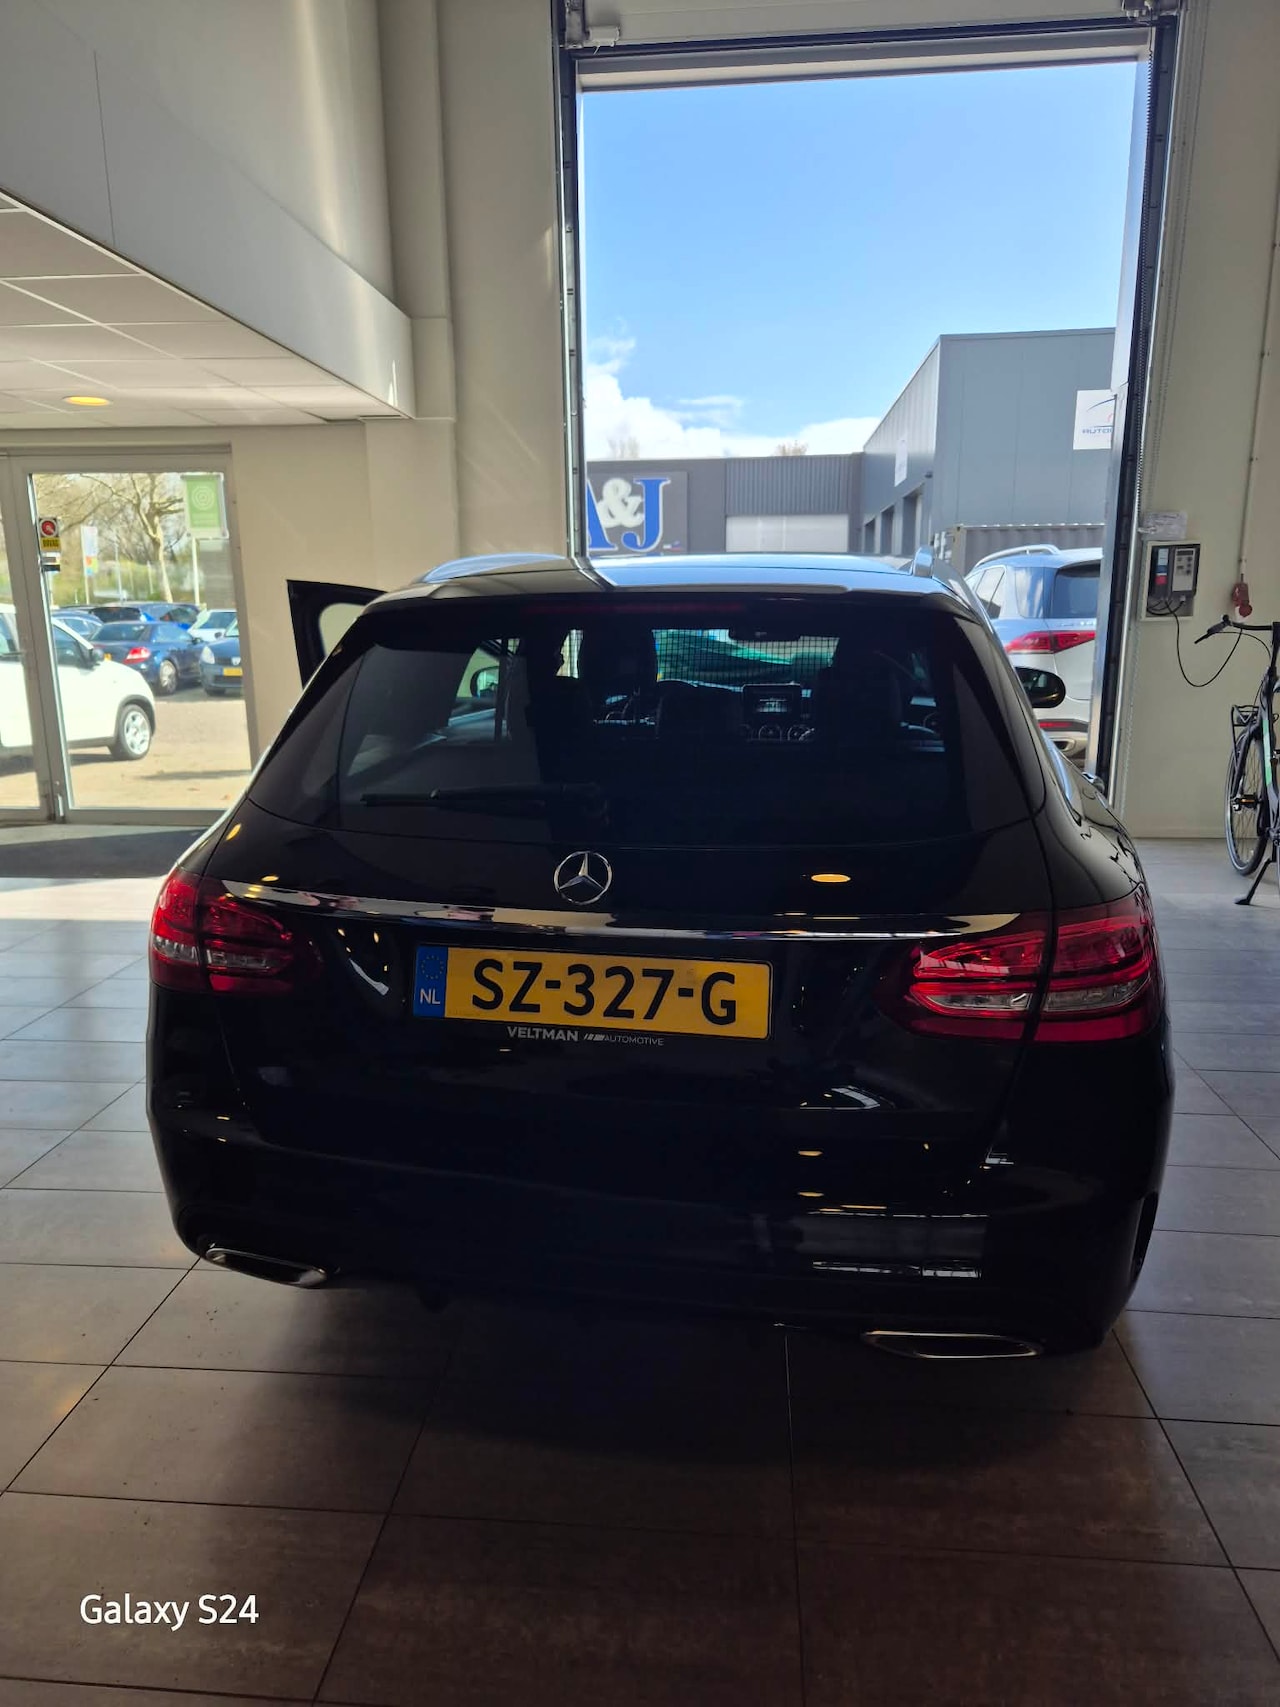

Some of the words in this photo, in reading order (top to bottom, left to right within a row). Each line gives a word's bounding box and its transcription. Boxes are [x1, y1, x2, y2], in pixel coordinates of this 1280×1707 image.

[420, 988, 441, 1005] NL
[472, 958, 737, 1026] SZ-327-G
[507, 1026, 579, 1042] VELTMAN
[604, 1035, 664, 1046] AUTOMOTIVE
